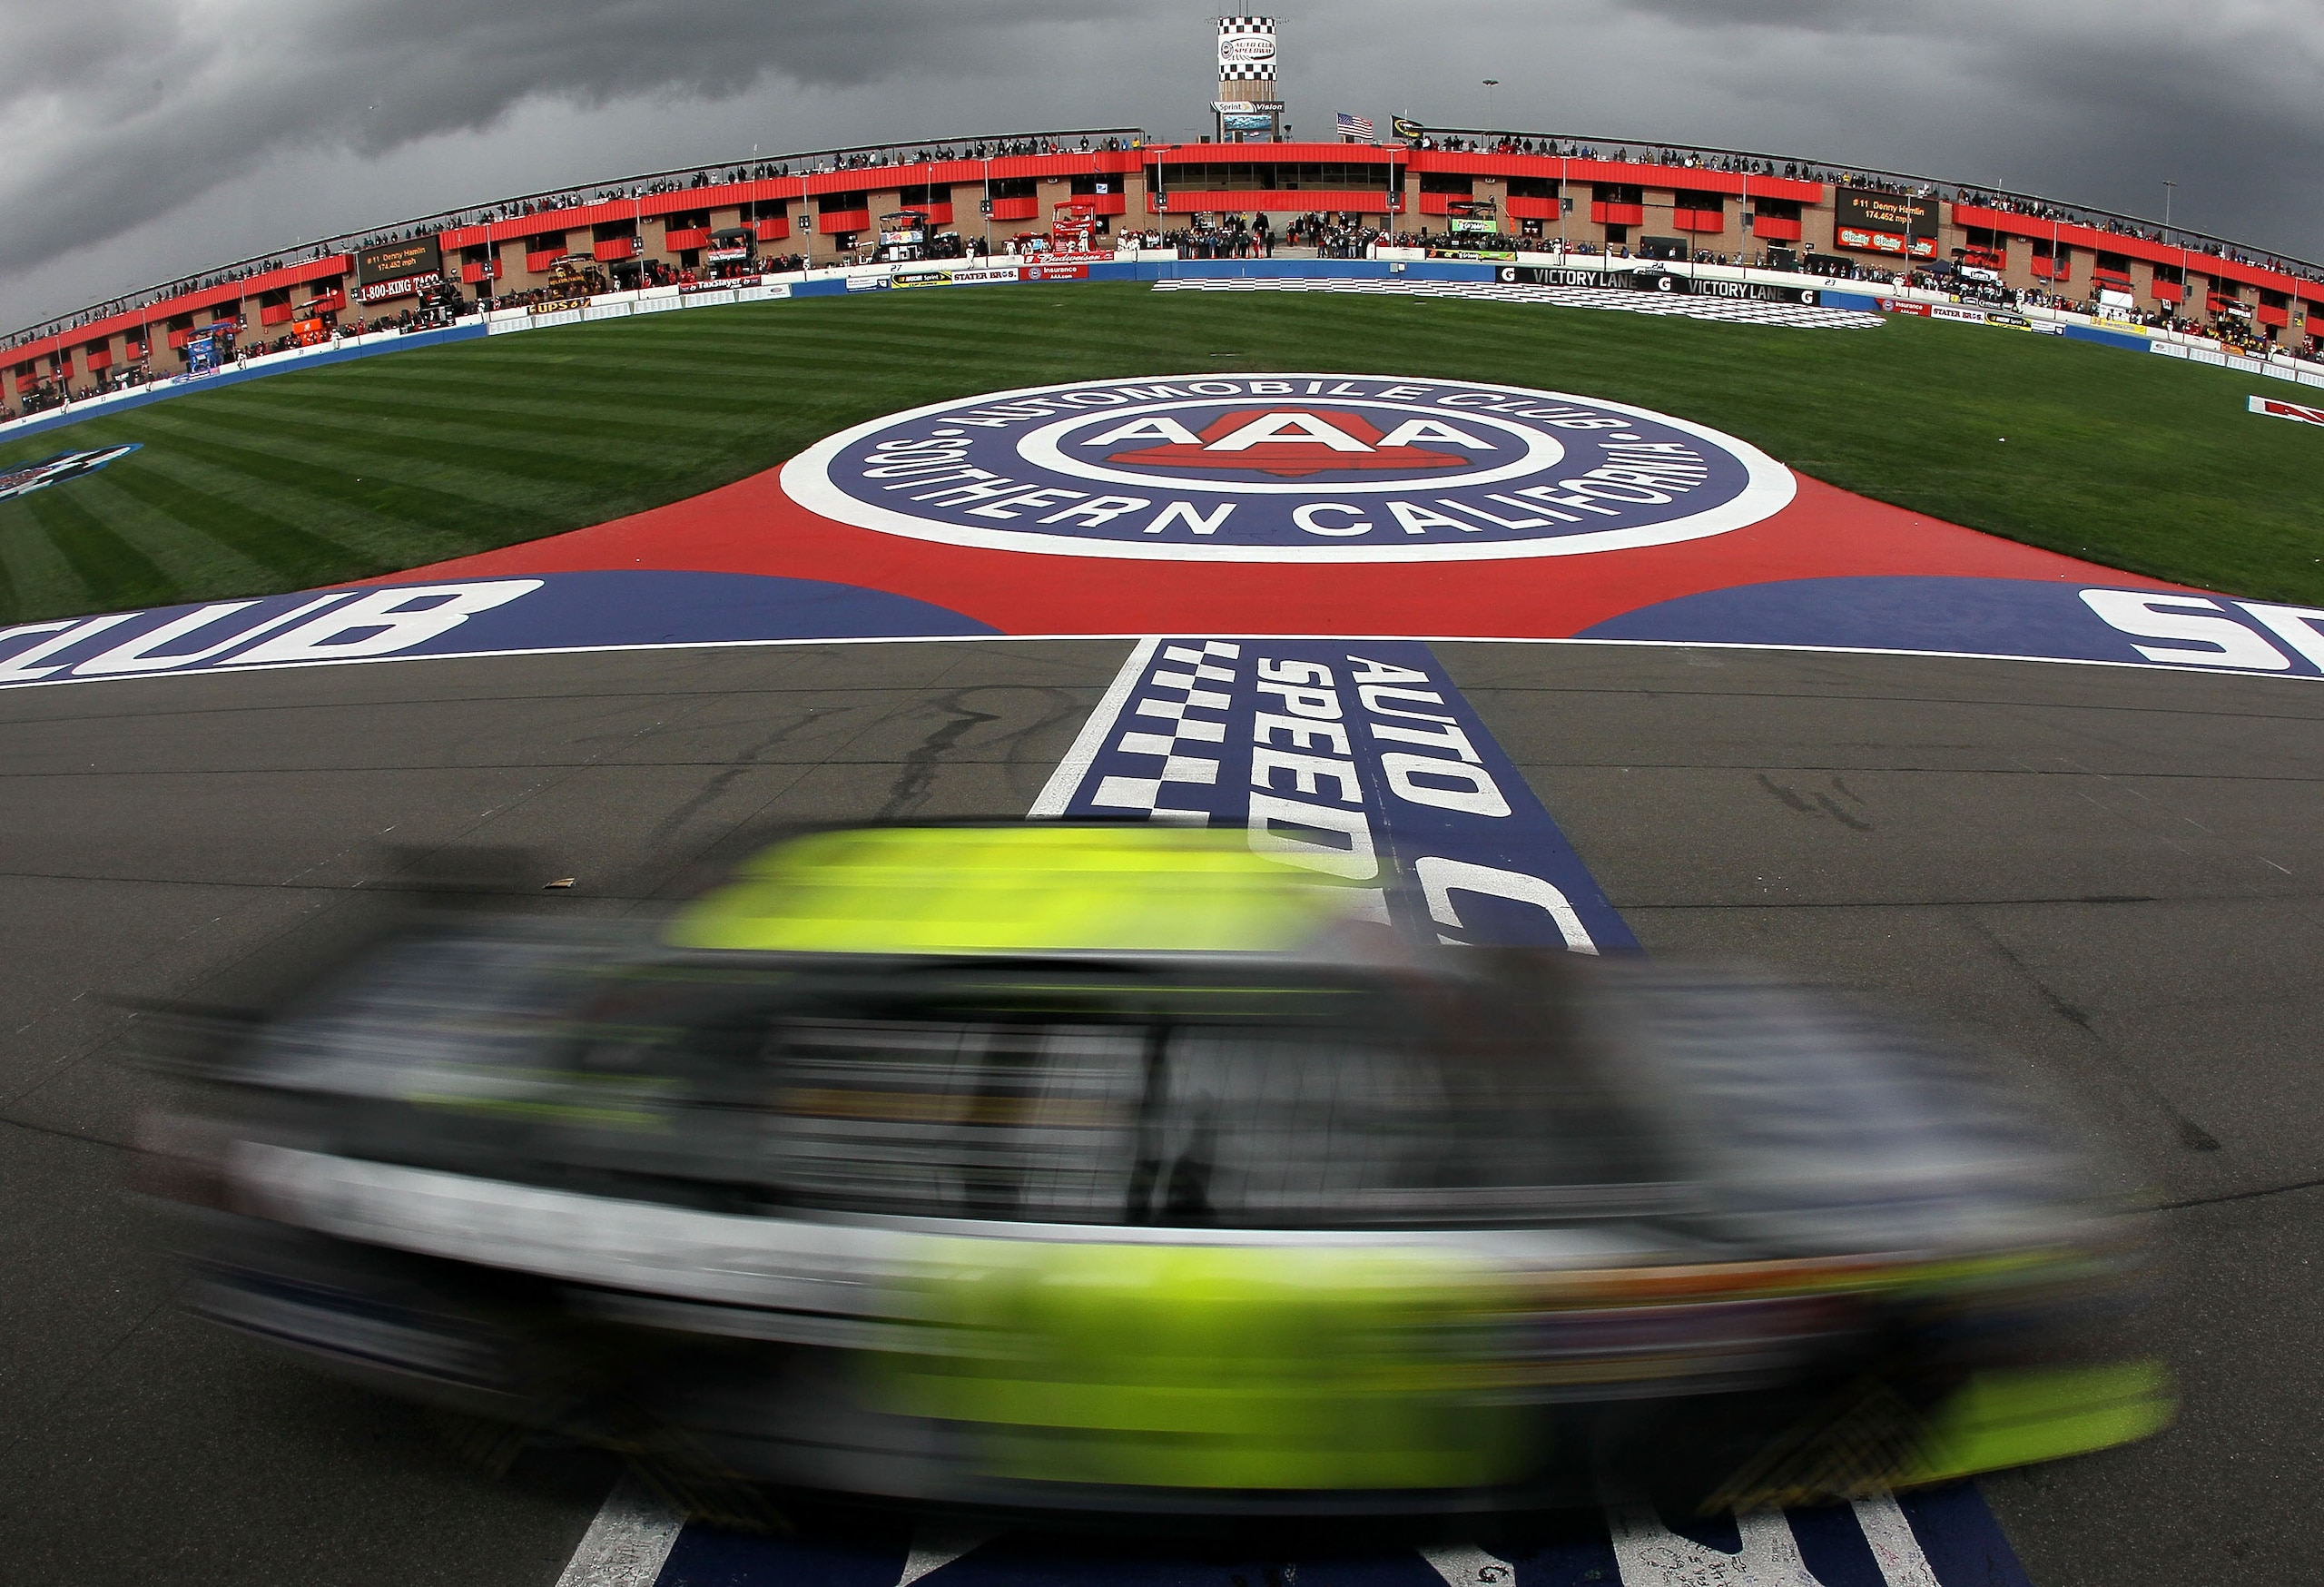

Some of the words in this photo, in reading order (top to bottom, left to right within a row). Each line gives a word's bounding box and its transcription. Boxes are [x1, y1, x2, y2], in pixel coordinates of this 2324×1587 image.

[1219, 103, 1241, 112] Sprint
[1873, 201, 1897, 213] Denny
[1899, 205, 1925, 216] Hamlin
[1866, 210, 1894, 222] 174.452
[383, 251, 402, 261] Denny
[404, 247, 426, 257] Hamlin
[1915, 242, 1933, 254] eilly
[402, 258, 417, 266] mph
[1024, 255, 1033, 263] 9
[1037, 252, 1102, 263] Budweiser
[954, 272, 989, 281] STATER
[990, 271, 1017, 279] BROS.
[1501, 267, 1515, 282] G
[1533, 268, 1596, 287] VICTORY
[1600, 272, 1638, 289] LANE
[361, 280, 411, 301] 1-800-KING
[697, 278, 741, 290] TaxSlayer
[1658, 276, 1671, 291] G
[1688, 279, 1748, 299] VICTORY
[1750, 284, 1786, 301] LANE
[1801, 290, 1813, 304] G
[537, 301, 568, 313] UPS
[1895, 301, 1923, 310] Insurance
[1933, 309, 1961, 318] STATER
[936, 380, 1434, 429] AUTOMOBILE
[1436, 392, 1632, 431] CLUB
[1080, 411, 1499, 453] AAA
[862, 438, 1238, 536] SOUTHERN
[1291, 442, 1709, 537] CALIFORNIA
[1345, 654, 1512, 818] AUTO
[1246, 656, 1392, 926] SPEED
